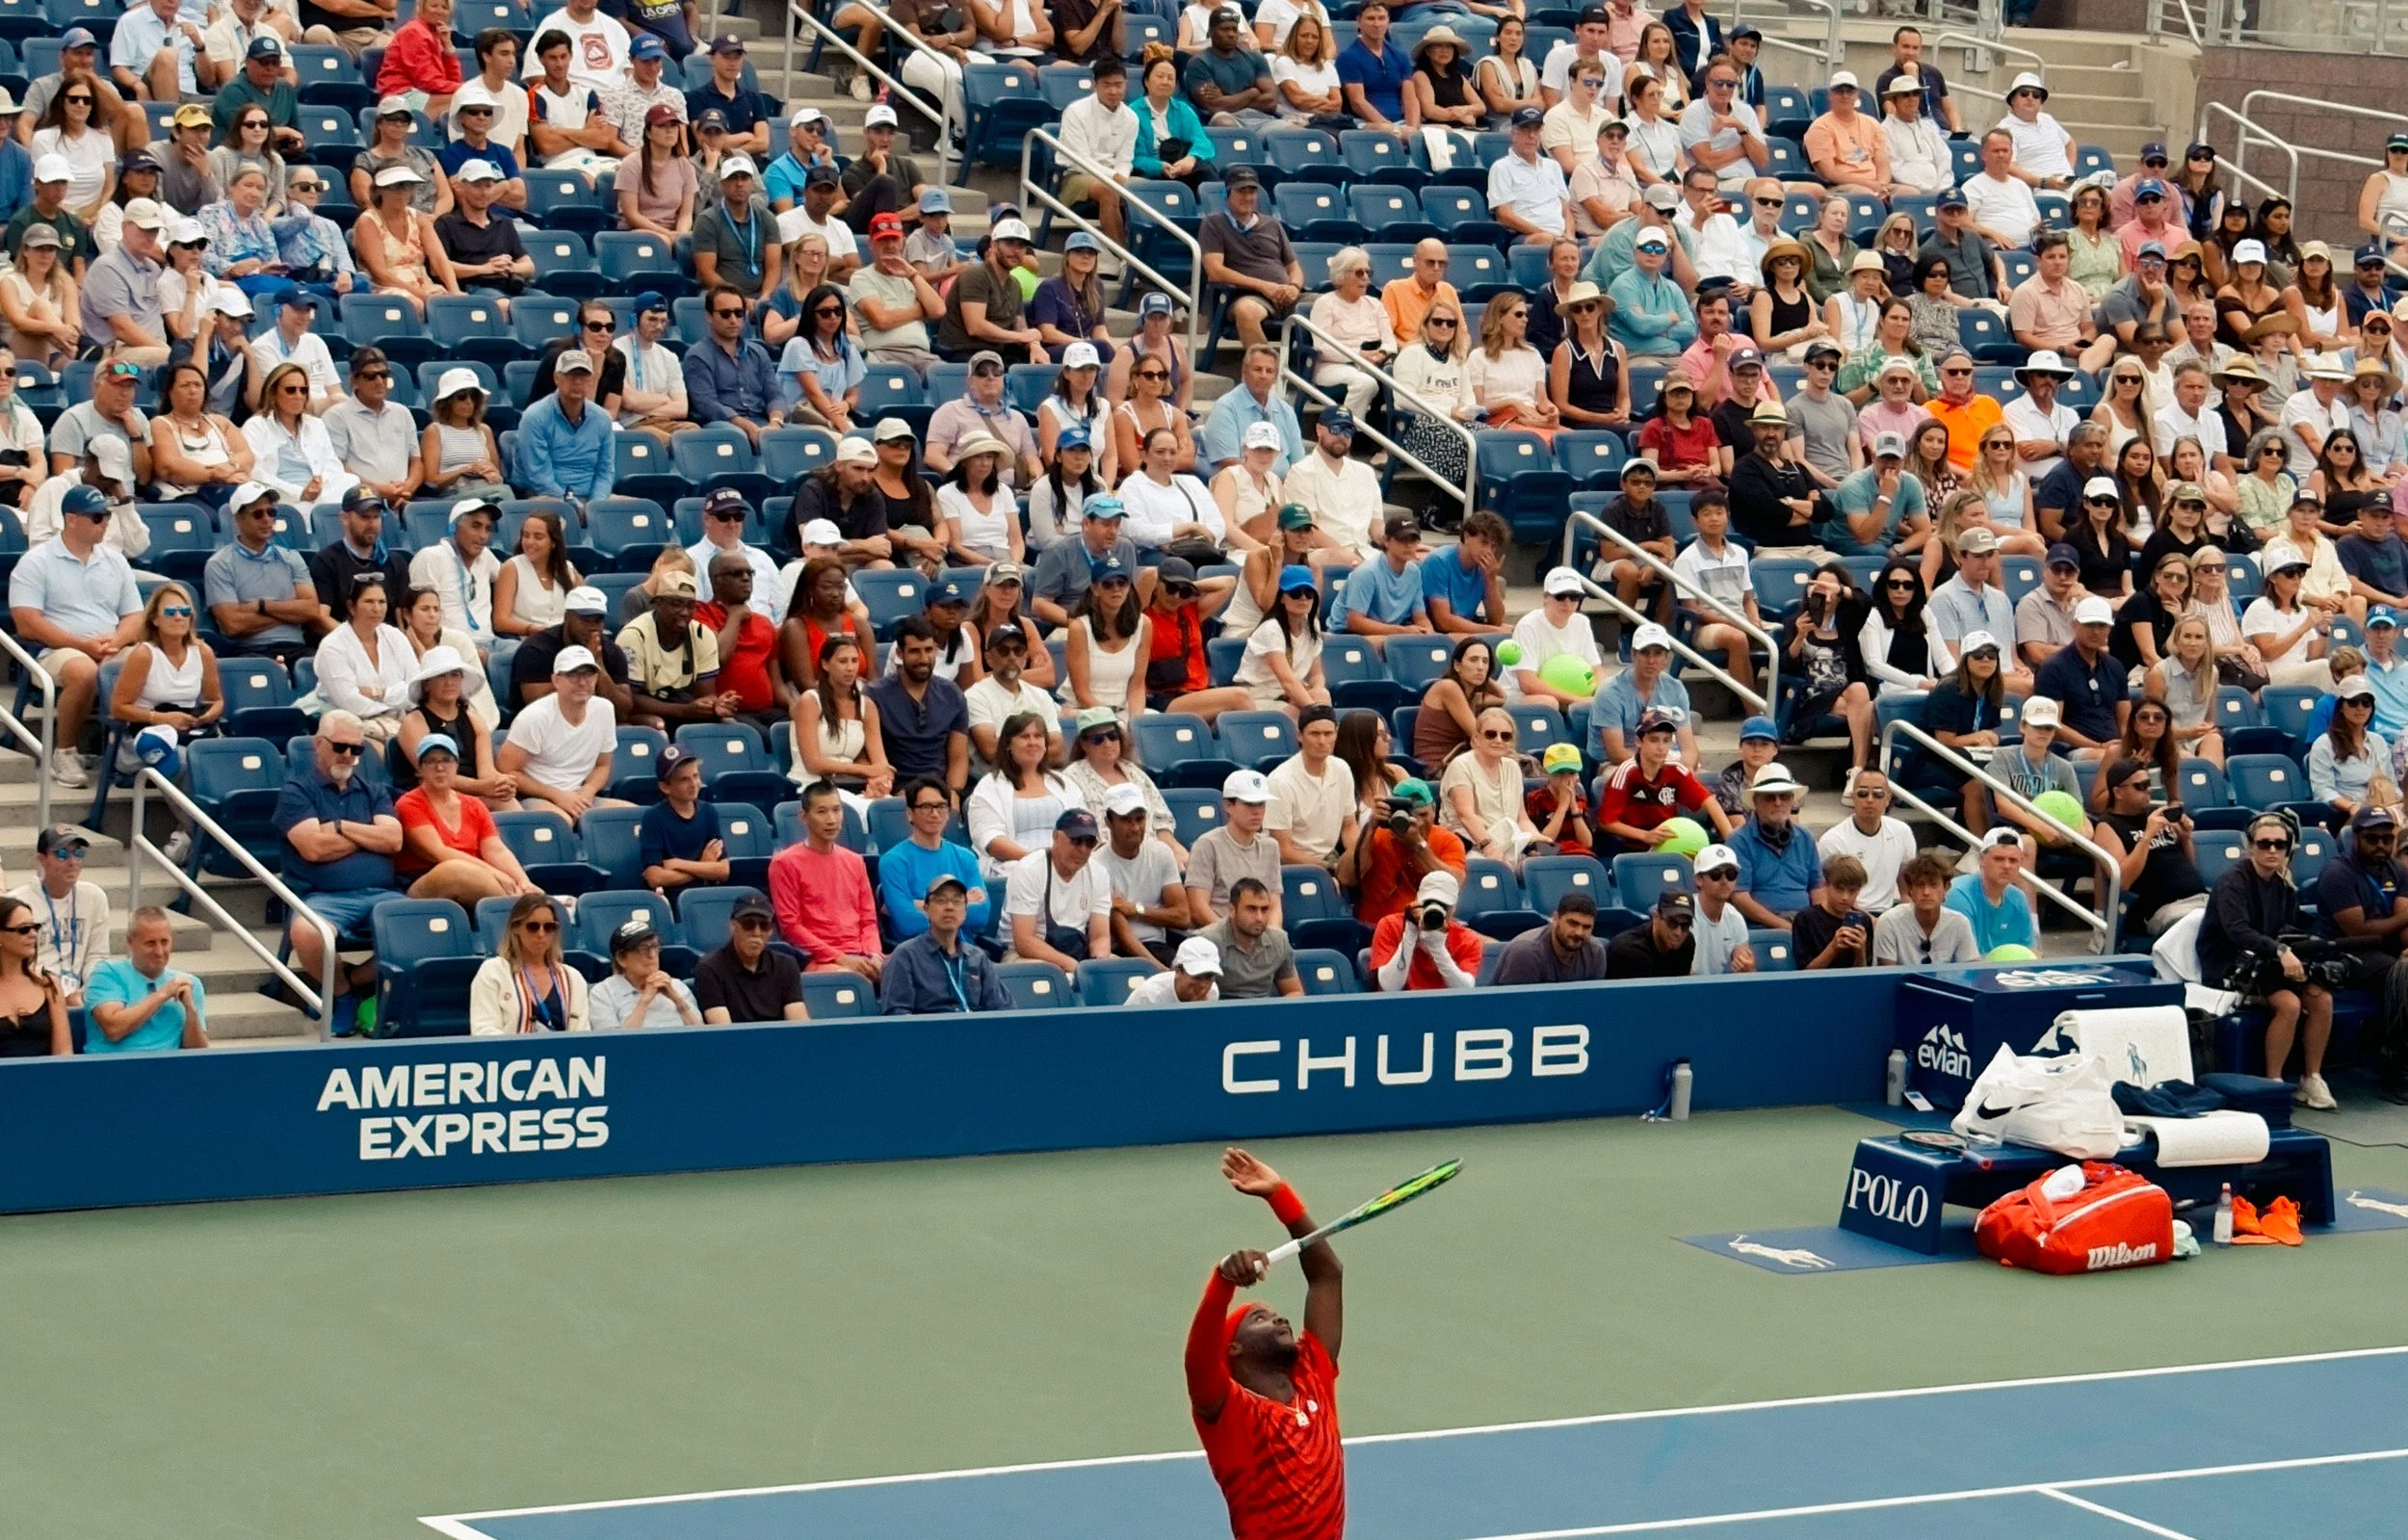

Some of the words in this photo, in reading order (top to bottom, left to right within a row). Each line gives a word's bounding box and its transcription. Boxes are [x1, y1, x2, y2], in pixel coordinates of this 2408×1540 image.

[316, 1056, 606, 1111] AMERICAN
[1222, 1024, 1590, 1093] CHUBB
[1918, 1043, 1971, 1079] evian
[359, 1106, 610, 1161] EXPRESS
[1847, 1167, 1929, 1228] POLO
[2087, 1241, 2157, 1269] Wilson
